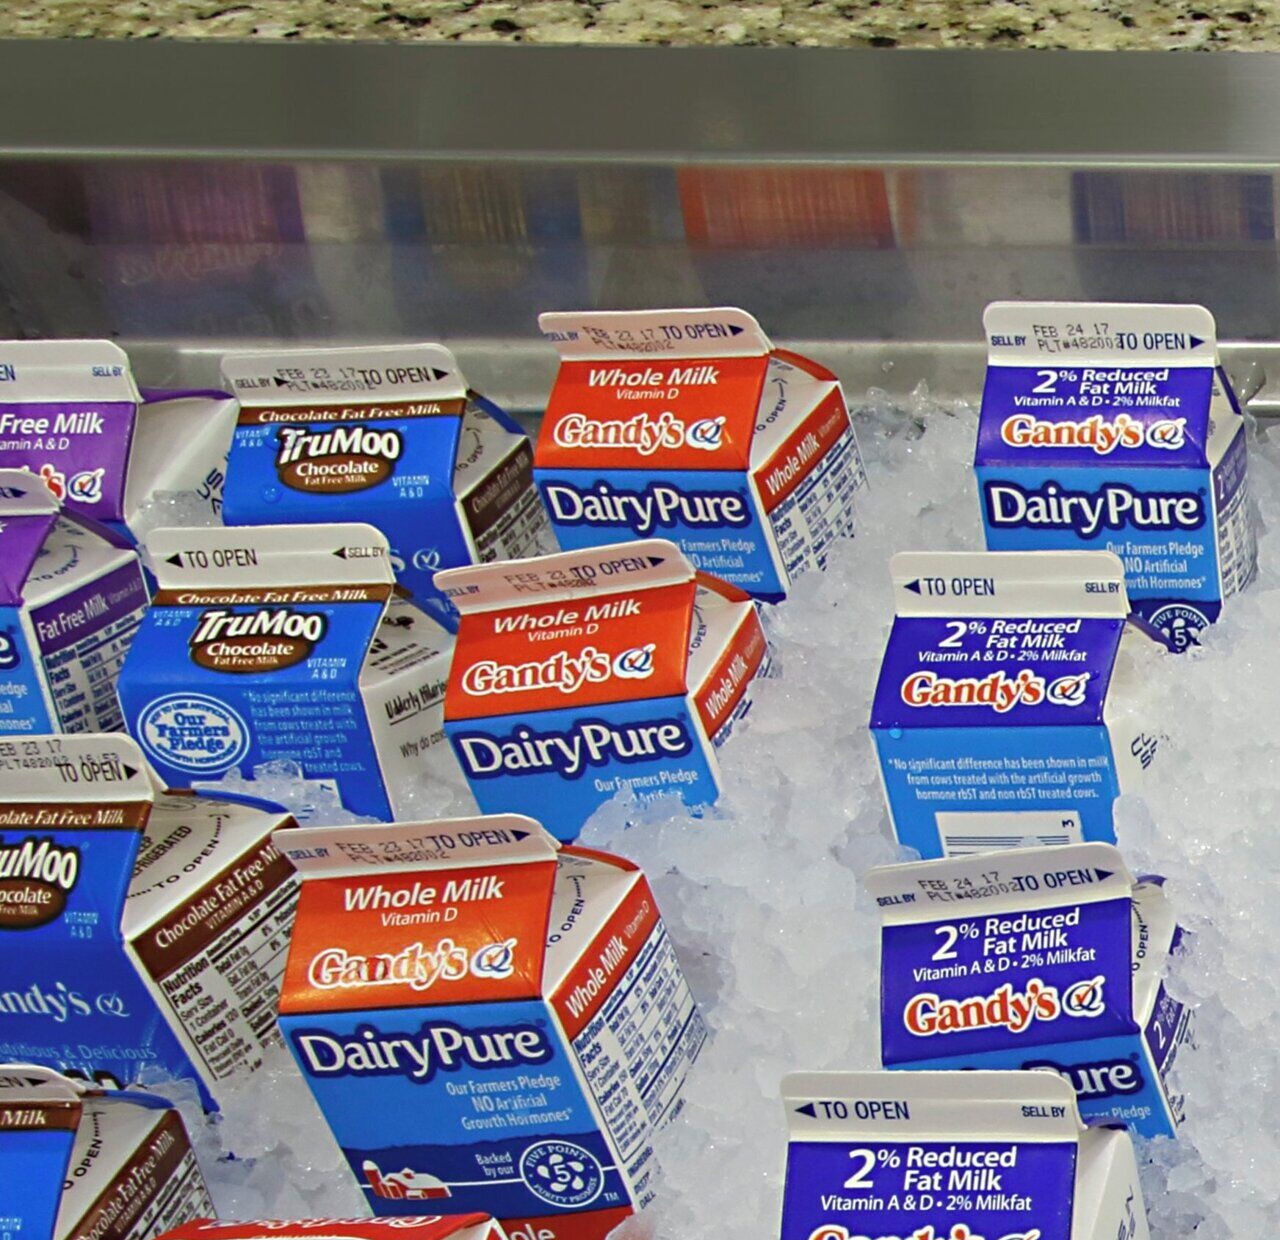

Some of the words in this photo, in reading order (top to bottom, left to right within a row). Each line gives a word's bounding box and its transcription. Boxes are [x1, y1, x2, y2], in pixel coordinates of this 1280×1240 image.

[991, 336, 1014, 346] SELL
[1016, 336, 1026, 346] BY
[1033, 325, 1058, 338] FEB
[1067, 324, 1083, 335] 24
[1094, 323, 1109, 335] 17
[1116, 333, 1137, 350] TO
[1144, 333, 1185, 350] OPEN
[92, 367, 110, 377] SELL
[112, 367, 123, 376] BY
[358, 369, 382, 386] TO
[386, 368, 430, 385] OPEN
[588, 369, 663, 387] Whole
[668, 366, 720, 385] Milk
[1032, 370, 1077, 393] 2%
[1082, 370, 1169, 382] Reduced
[616, 389, 664, 400] Vitamin
[667, 388, 679, 399] D
[1079, 383, 1110, 395] Fat
[1114, 383, 1157, 395] Milk
[1014, 396, 1065, 407] Vitamin
[1067, 396, 1077, 406] A
[1079, 396, 1089, 406] &
[1091, 396, 1103, 406] D
[1112, 396, 1133, 407] 2%
[1136, 396, 1180, 407] Milkfat
[1, 413, 50, 434] Free
[54, 413, 104, 434] Milk
[259, 410, 338, 422] Chocolate
[341, 409, 368, 420] Fat
[371, 407, 403, 419] Free
[407, 404, 441, 415] Milk
[554, 412, 685, 455] Gandy's
[1001, 414, 1143, 454] Gandy's
[279, 427, 400, 464] TruMoo
[296, 460, 378, 475] Chocolate
[547, 485, 746, 530] DairyPure
[990, 487, 1200, 533] DairyPure
[185, 551, 208, 567] TO
[213, 549, 258, 567] OPEN
[348, 548, 370, 558] SELL
[372, 547, 384, 557] BY
[1124, 558, 1143, 573] NO
[1145, 559, 1187, 573] Artificial
[178, 593, 258, 605] Chocolate
[262, 592, 289, 604] Fat
[293, 591, 325, 603] Free
[329, 589, 368, 601] Milk
[924, 579, 945, 595] TO
[952, 578, 994, 595] OPEN
[37, 620, 58, 642] Fat
[59, 607, 85, 633] Free
[86, 594, 109, 619] Milk
[493, 612, 577, 634] Whole
[584, 598, 642, 622] Milk
[195, 611, 323, 643] TruMoo
[938, 621, 986, 648] 2%
[991, 619, 1080, 634] Reduced
[207, 643, 294, 656] Chocolate
[986, 635, 1017, 649] Fat
[1021, 634, 1064, 648] Milk
[461, 647, 610, 695] Gandy's
[902, 669, 1044, 712] Gandy's
[460, 724, 686, 773] DairyPure
[595, 779, 615, 793] Our
[616, 773, 658, 790] Farmers
[660, 769, 698, 785] Pledge
[432, 835, 455, 850] TO
[459, 829, 509, 848] OPEN
[918, 879, 948, 891] FEB
[954, 876, 972, 888] 24
[983, 871, 999, 883] 17
[1015, 876, 1038, 892] TO
[1044, 869, 1092, 888] OPEN
[155, 895, 219, 948] Chocolate
[215, 878, 238, 901] Fat
[235, 859, 265, 888] Free
[344, 884, 435, 911] Whole
[441, 877, 505, 903] Milk
[380, 910, 440, 927] Vitamin
[444, 907, 458, 922] D
[932, 923, 979, 961] 2%
[985, 907, 1080, 935] Reduced
[983, 937, 1016, 956] Fat
[1021, 932, 1068, 951] Milk
[309, 938, 469, 990] Gandy's
[162, 956, 210, 994] Nutrition
[904, 979, 1060, 1036] Gandy's
[300, 1027, 546, 1077] DairyPure
[820, 1102, 848, 1120] TO
[856, 1101, 911, 1120] OPEN
[476, 1153, 512, 1166] Backed
[526, 1148, 548, 1168] FIVE
[549, 1144, 588, 1161] POINT
[484, 1166, 497, 1178] by
[498, 1165, 514, 1175] our
[556, 1164, 570, 1183] 5
[844, 1149, 901, 1190] 2%
[907, 1147, 1017, 1167] Reduced
[904, 1170, 941, 1191] Fat
[947, 1169, 1002, 1191] Milk
